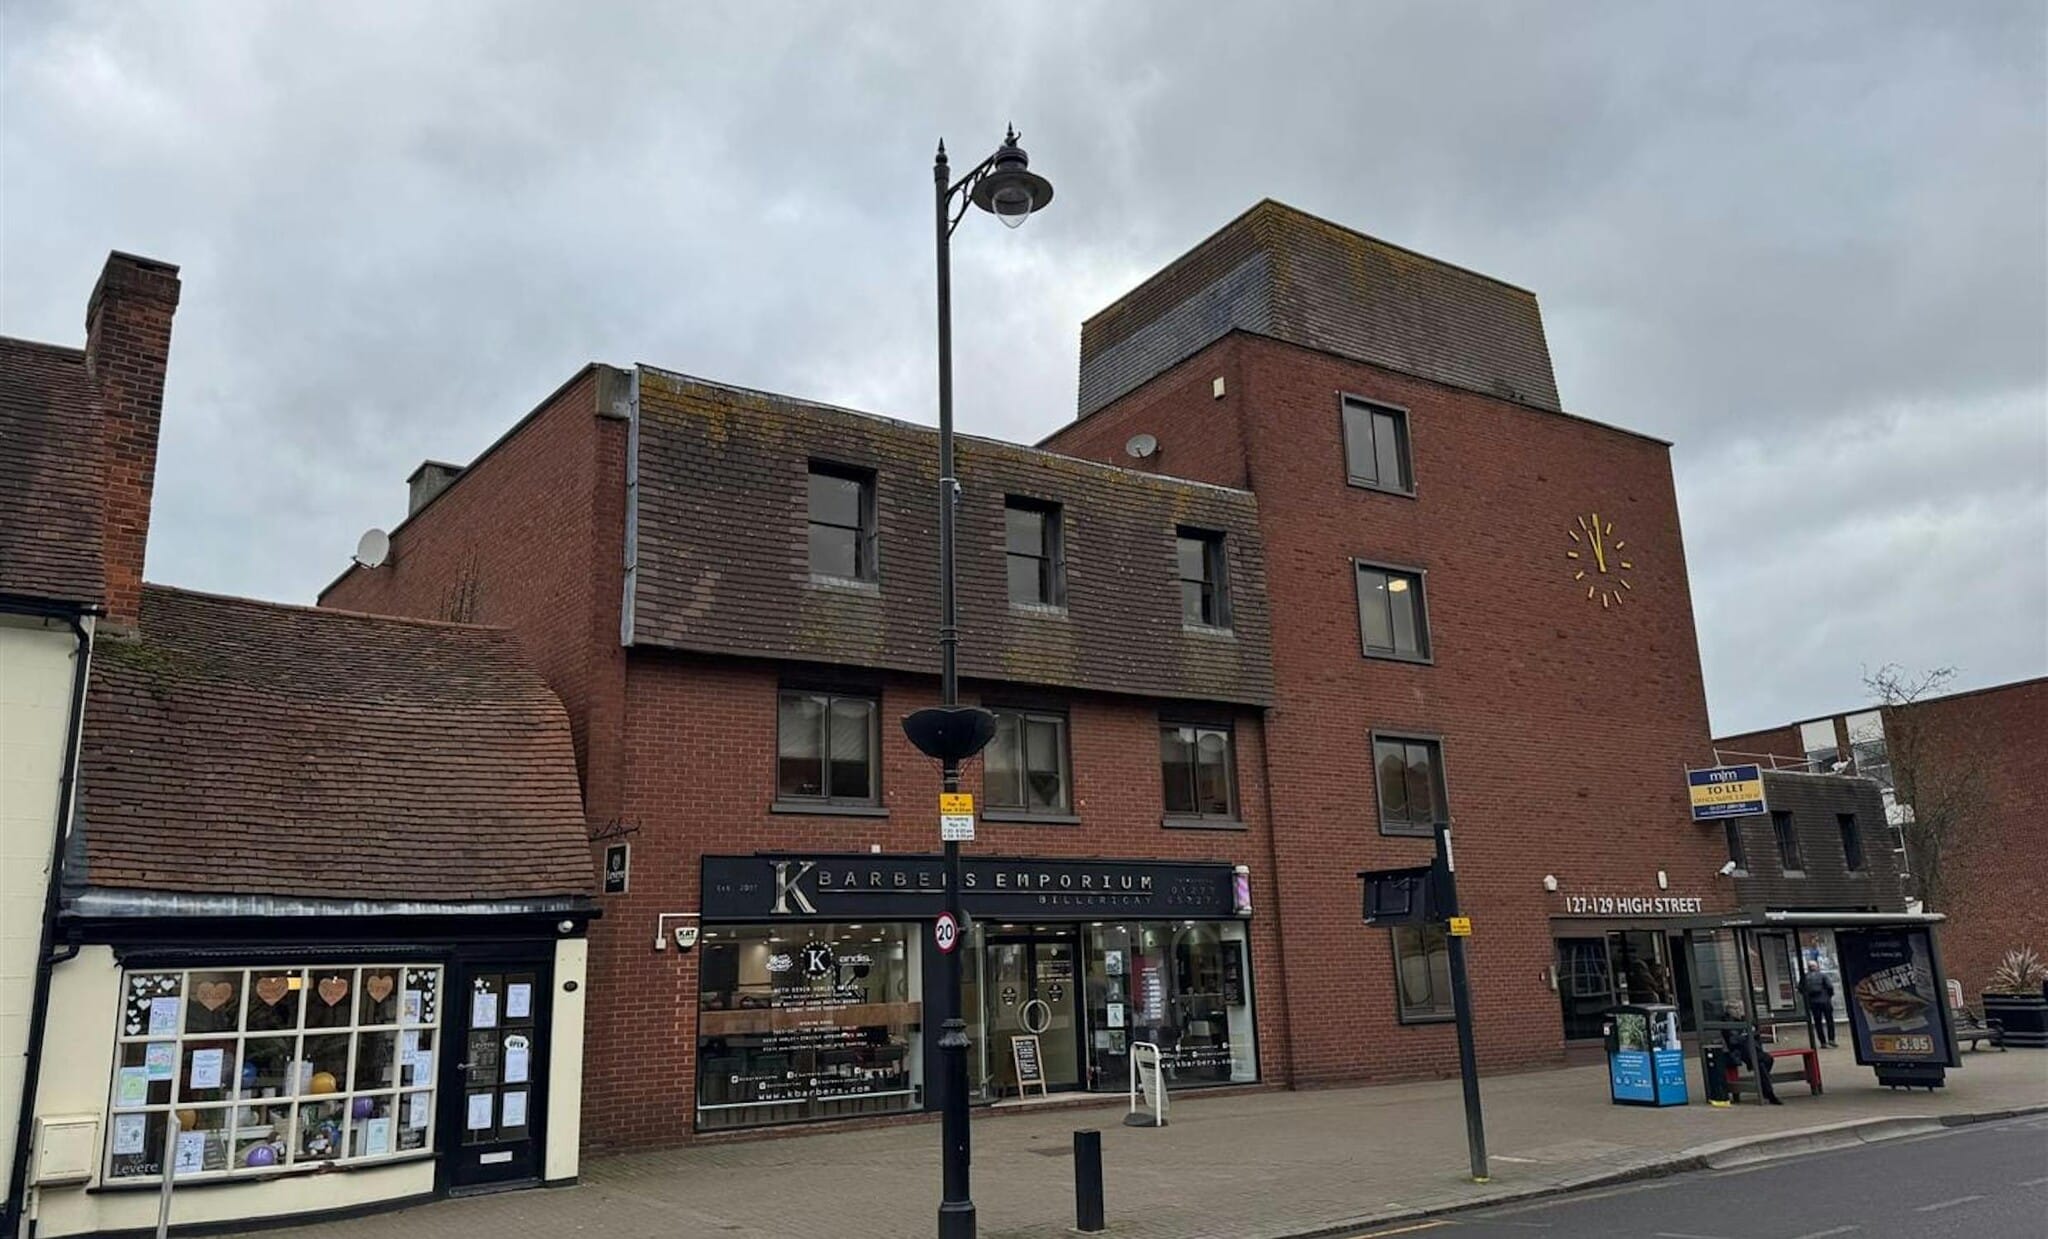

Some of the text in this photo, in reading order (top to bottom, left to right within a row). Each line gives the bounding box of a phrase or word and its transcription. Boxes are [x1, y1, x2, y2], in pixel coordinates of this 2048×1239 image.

[1707, 784, 1744, 795] TO LET
[769, 860, 817, 914] K
[819, 871, 1152, 889] BARBES EMPORIUM
[1038, 895, 1151, 905] BILLERICAY
[1566, 896, 1702, 913] 127-129 HIGH STREET
[937, 923, 953, 940] 20
[807, 950, 826, 971] K
[1867, 971, 1917, 996] LUNCH?
